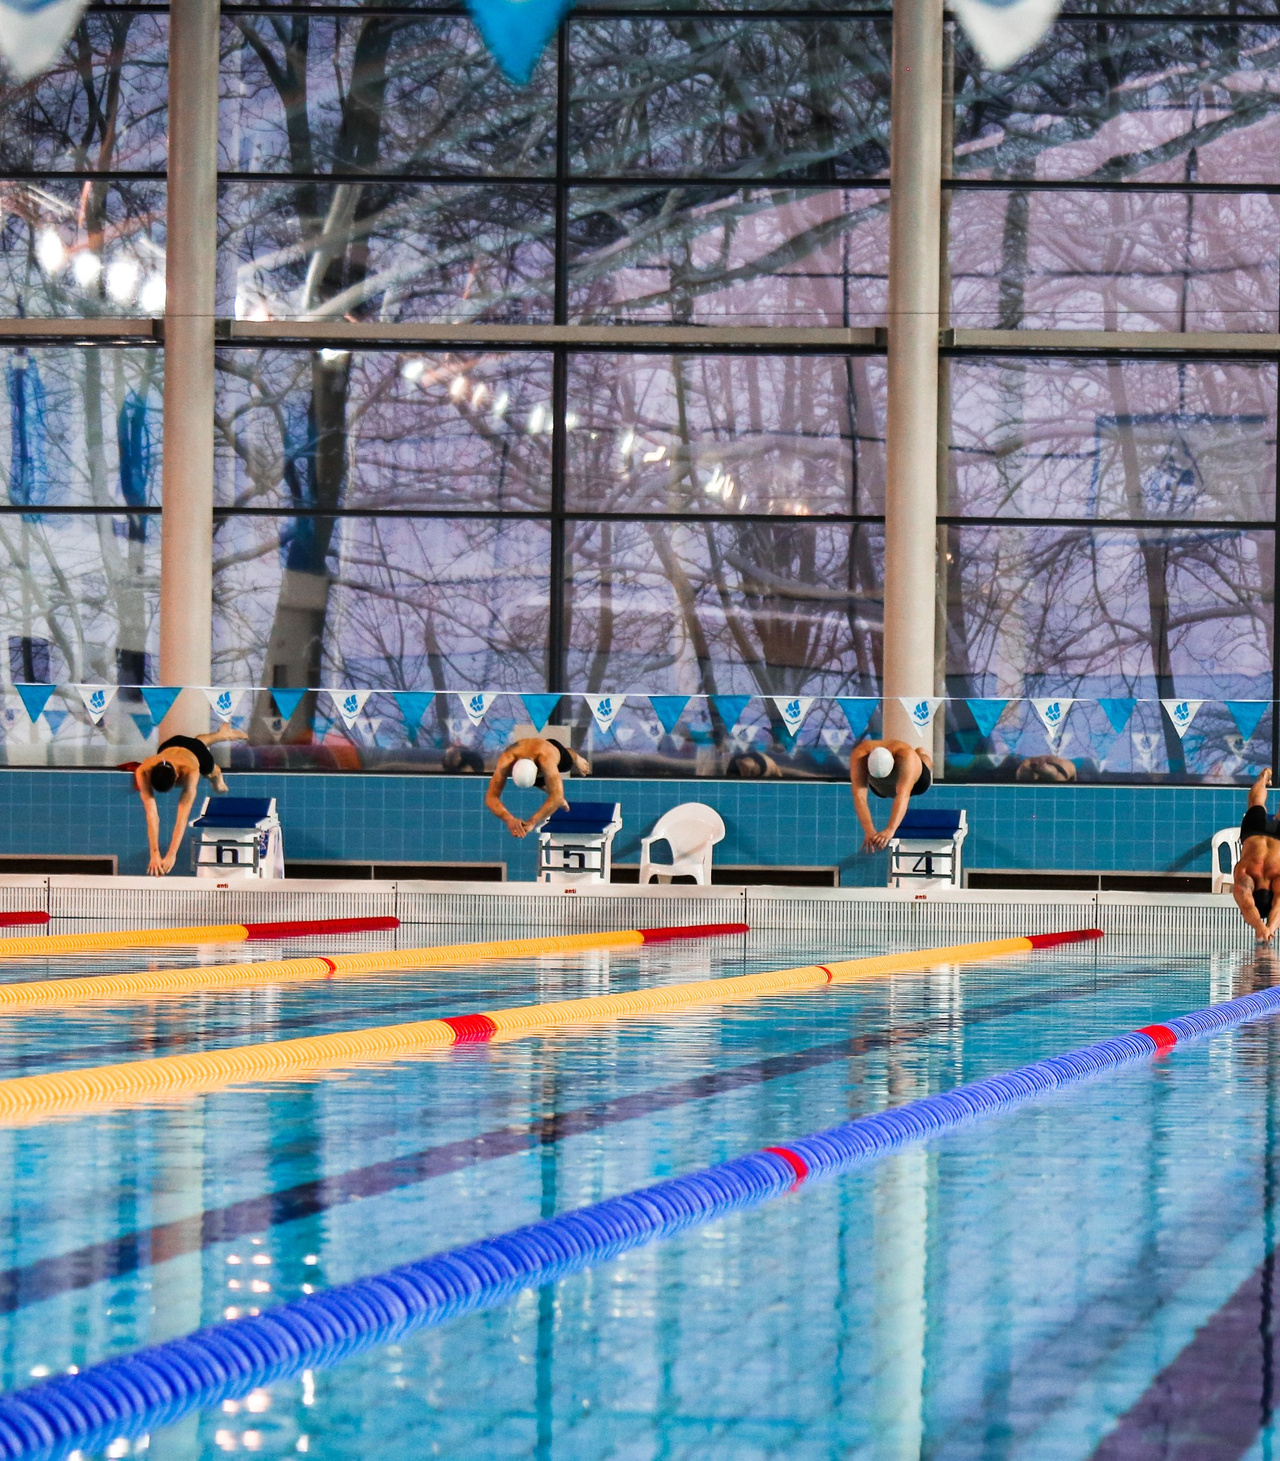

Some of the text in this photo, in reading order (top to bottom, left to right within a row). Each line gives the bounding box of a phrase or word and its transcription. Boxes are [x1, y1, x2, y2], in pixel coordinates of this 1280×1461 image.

[216, 839, 238, 868] 6
[563, 845, 586, 873] 5
[912, 851, 935, 879] 4
